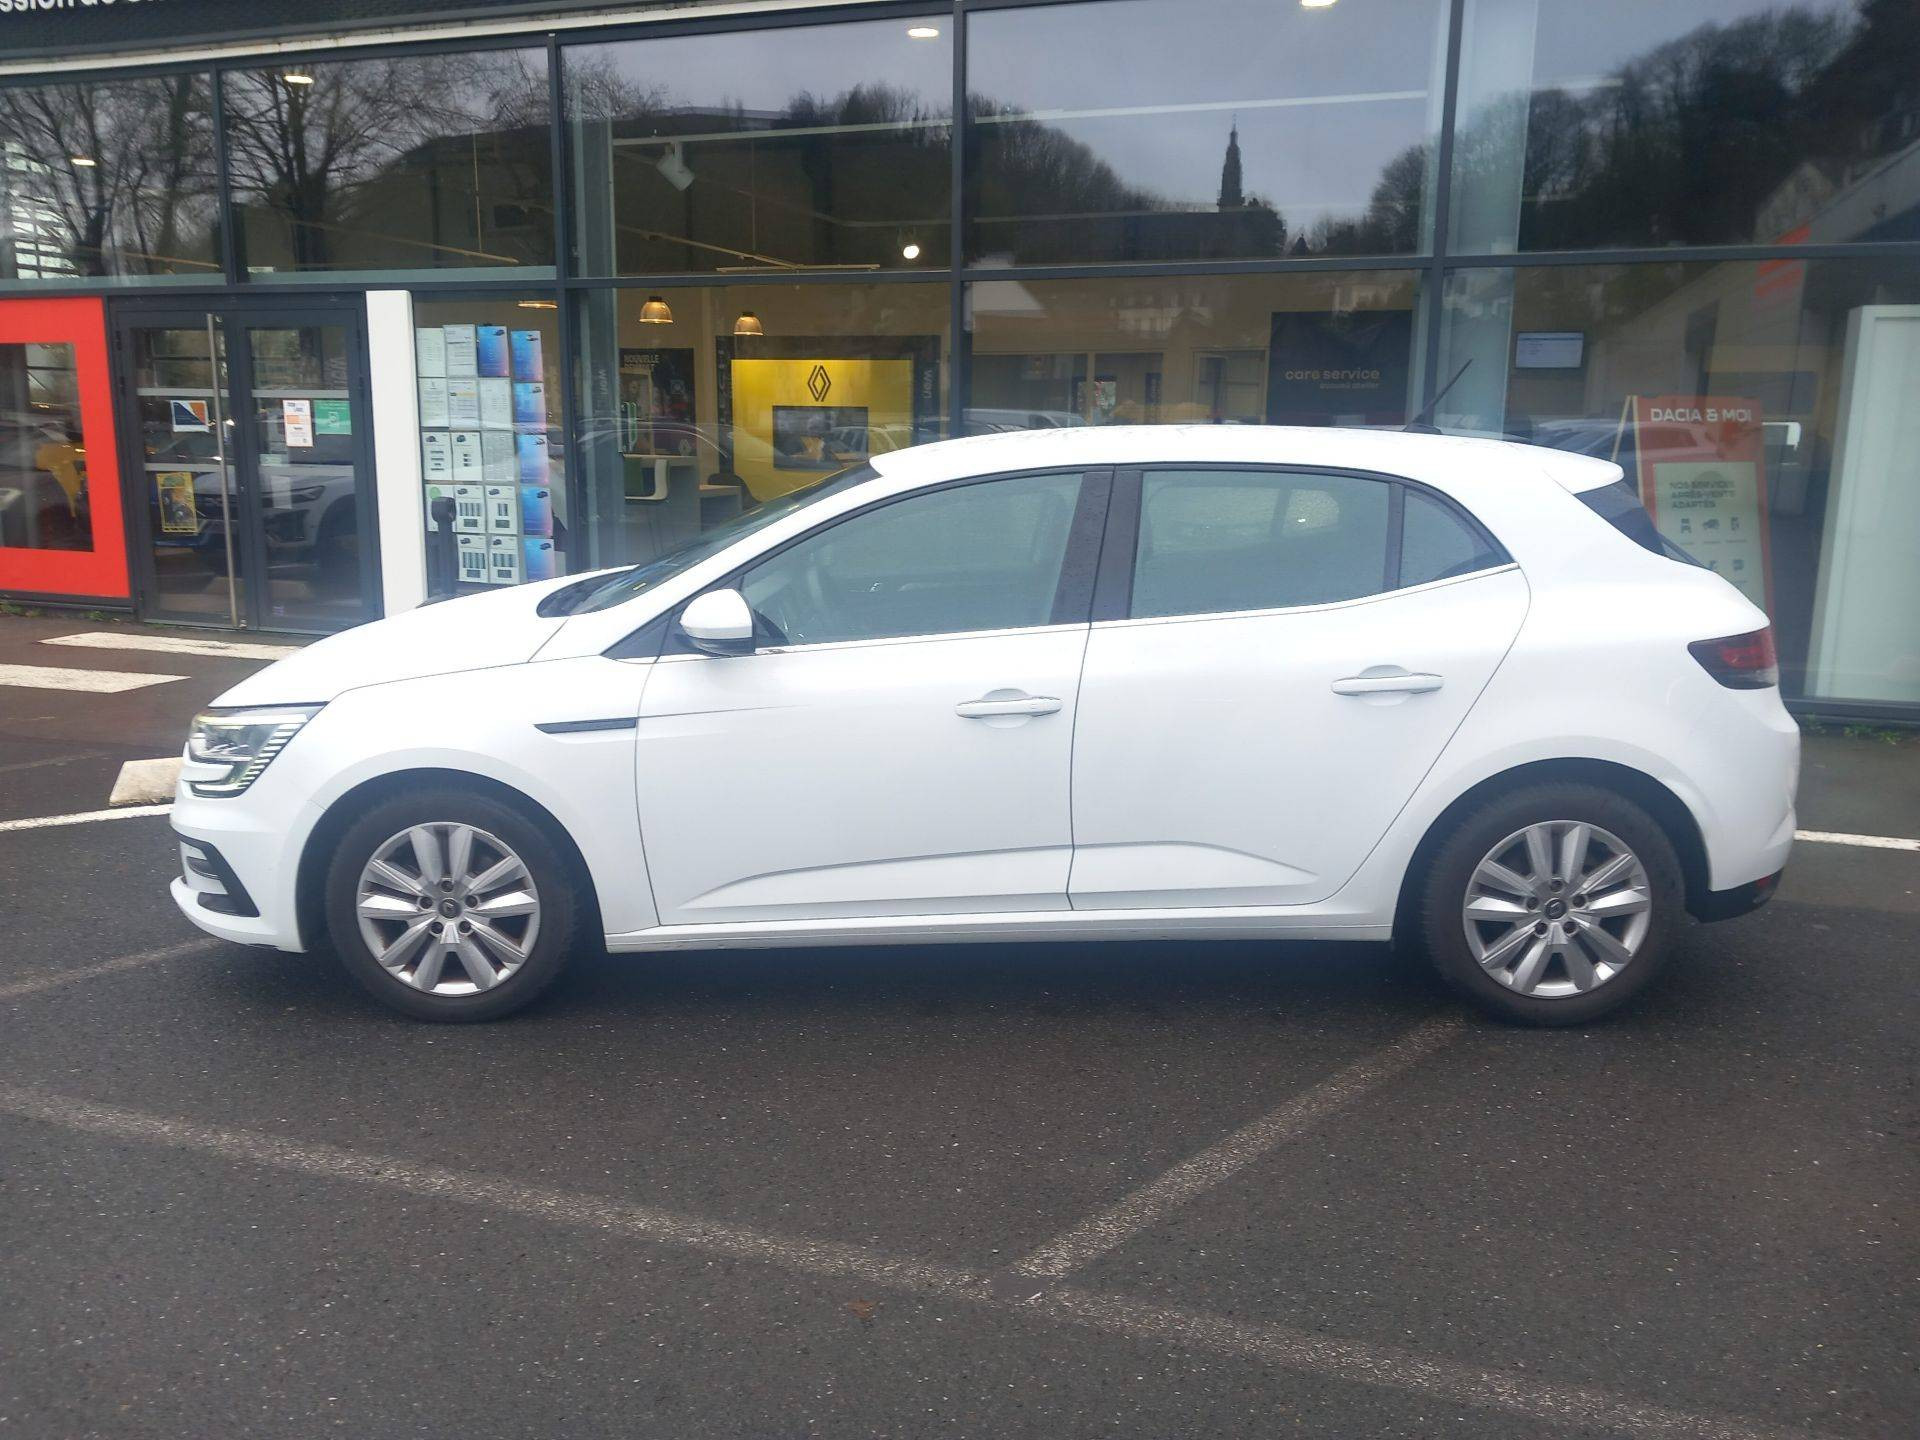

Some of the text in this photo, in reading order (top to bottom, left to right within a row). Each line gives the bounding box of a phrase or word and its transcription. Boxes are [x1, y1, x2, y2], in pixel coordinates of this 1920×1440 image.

[1284, 368, 1380, 380] care service
[1650, 408, 1702, 422] DACIA
[1722, 408, 1752, 421] MOI
